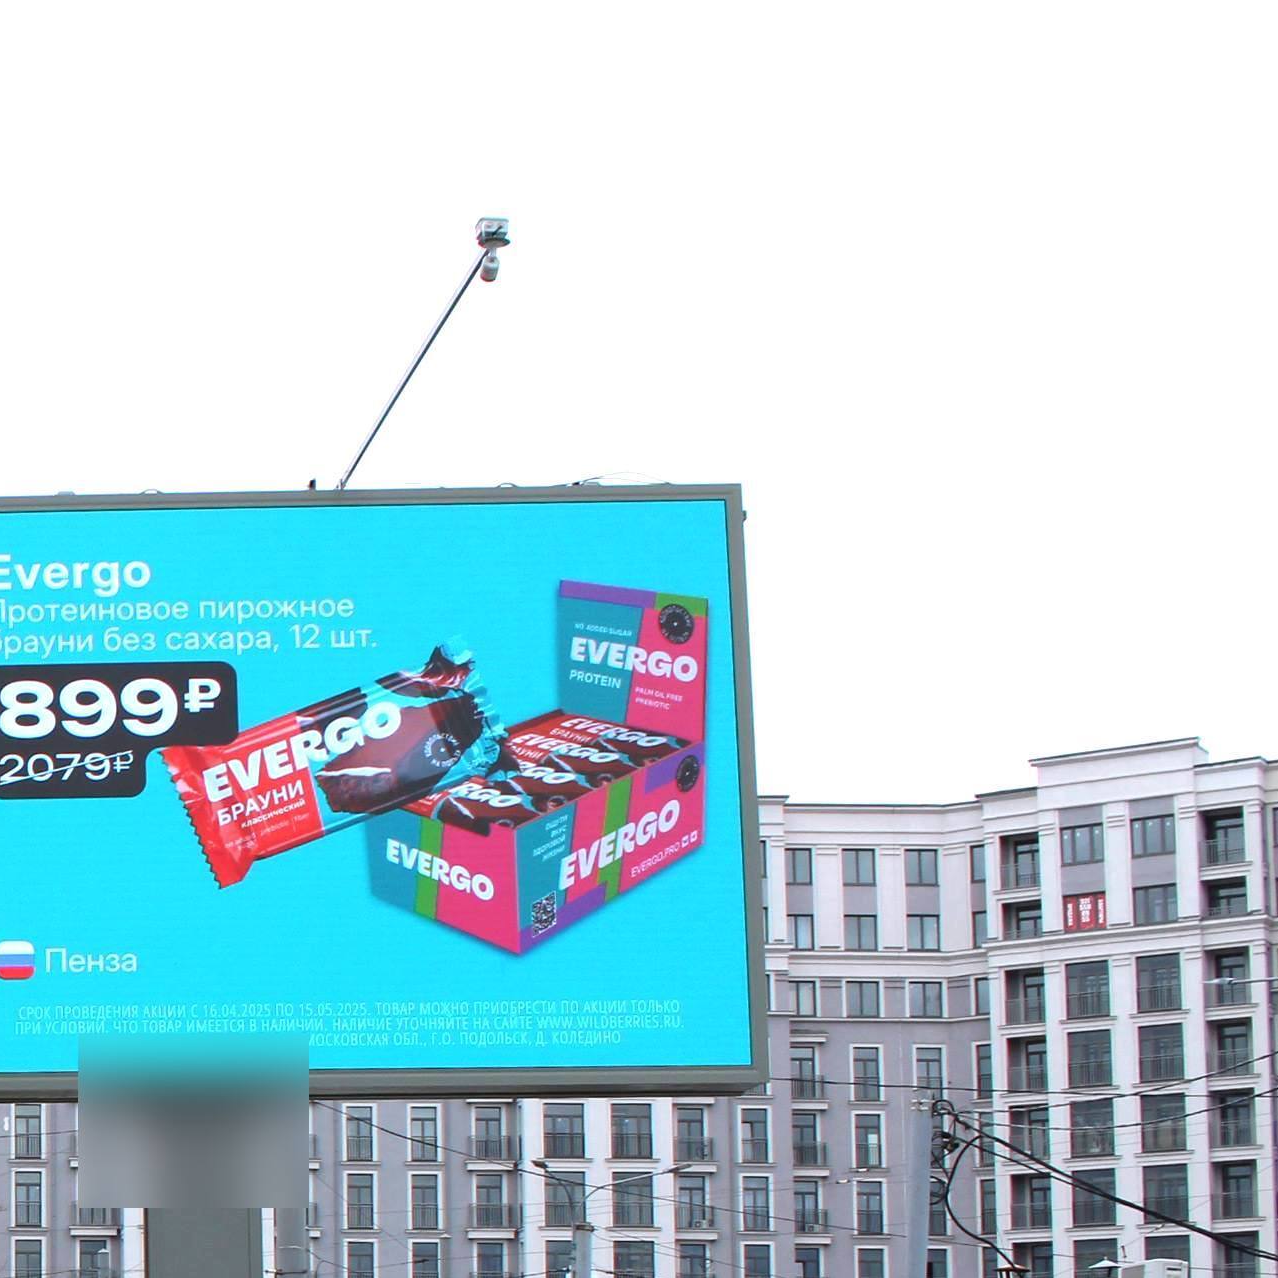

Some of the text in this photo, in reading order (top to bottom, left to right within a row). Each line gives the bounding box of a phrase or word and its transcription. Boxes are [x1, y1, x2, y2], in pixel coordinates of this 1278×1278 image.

[198, 597, 355, 624] пирожное
[103, 627, 157, 652] без
[165, 628, 280, 655] сахара,
[289, 624, 320, 650] 12
[329, 627, 378, 649] шт.
[569, 636, 698, 683] EVERGO
[569, 669, 622, 689] PROTEIN
[560, 717, 669, 747] EVERGO
[203, 701, 402, 803] EVERGO
[511, 733, 620, 763] EVERGO
[217, 780, 305, 827] БРАУНИ
[559, 799, 680, 891] EVERGO
[386, 838, 495, 901] EVERGO
[45, 948, 138, 973] Пенза
[18, 1005, 51, 1020] СРОК
[55, 1004, 139, 1021] ПРОВЕДЕНИЯ
[143, 1003, 186, 1020] АКЦИИ
[203, 1002, 271, 1018] 16.04.2025
[275, 1002, 294, 1017] ПО
[375, 1001, 415, 1016] ТОВАР
[419, 1001, 469, 1016] МОЖНО
[473, 1000, 556, 1015] ПРИОБРЕСТИ
[560, 1000, 579, 1014] ПО
[583, 999, 626, 1015] АКЦИИ
[630, 999, 680, 1014] ТОЛЬКО
[15, 1020, 41, 1035] ПРИ
[113, 1019, 138, 1034] ЧТО
[143, 1019, 183, 1034] ТОВАР
[186, 1018, 245, 1033] ИМЕЕТСЯ
[249, 1018, 257, 1032] В
[332, 1017, 392, 1032] НАЛИЧИЕ
[473, 1016, 490, 1030] НА
[552, 1030, 621, 1047] КОЛЕДИНО
